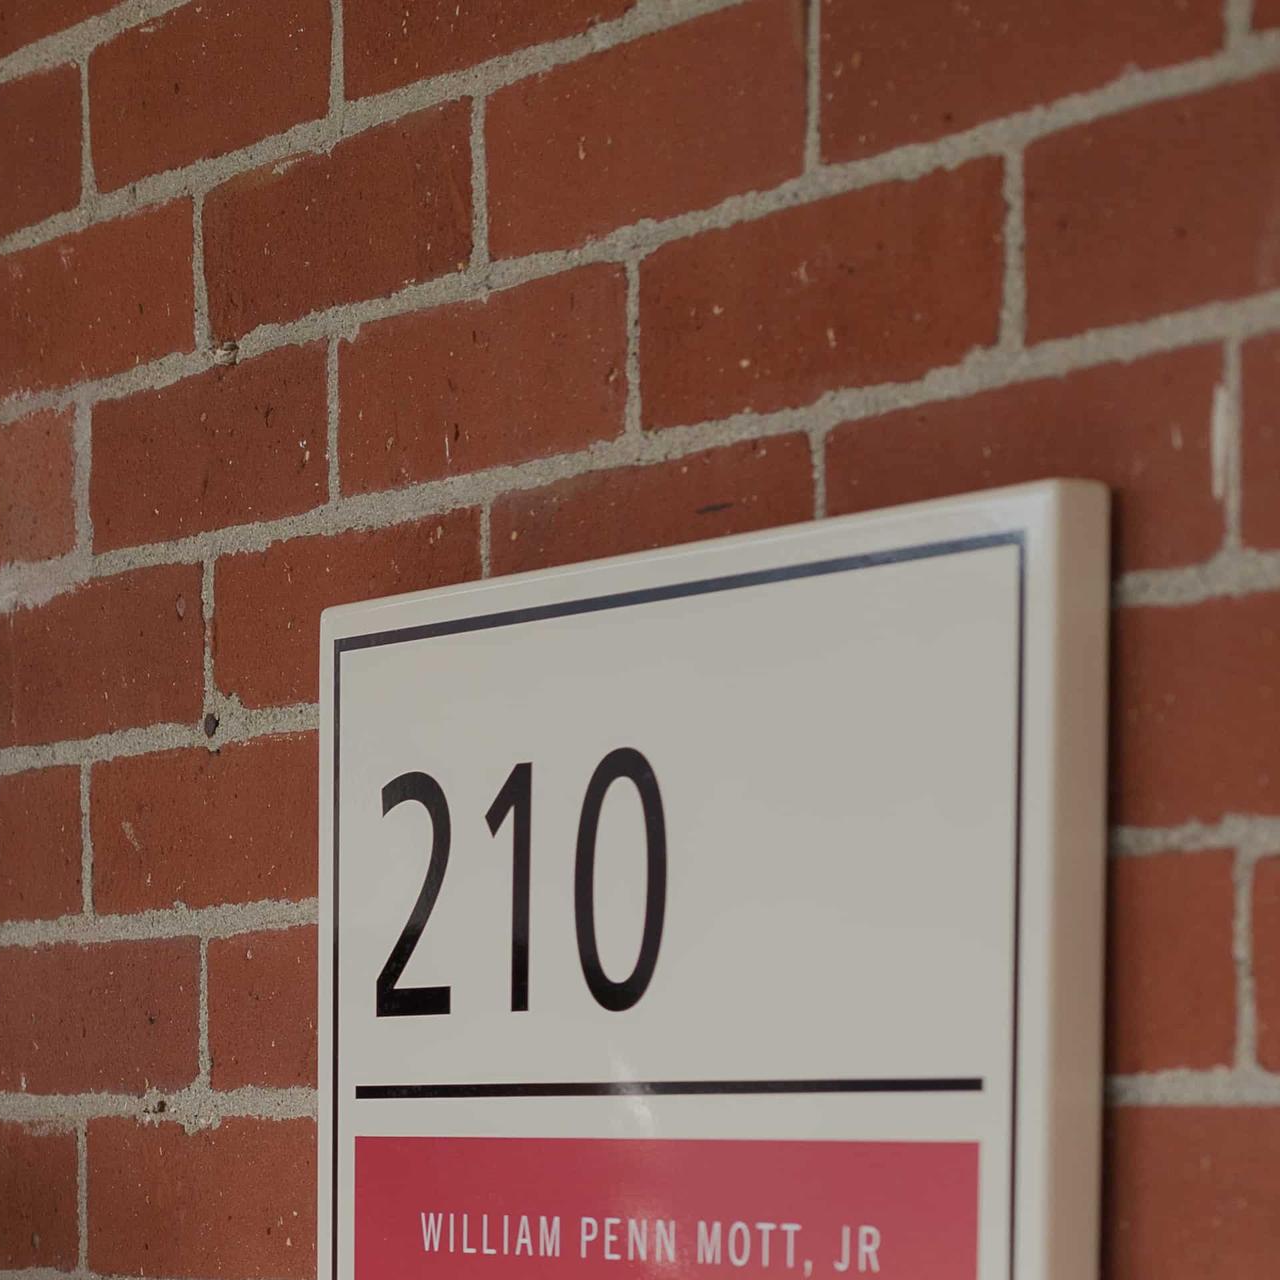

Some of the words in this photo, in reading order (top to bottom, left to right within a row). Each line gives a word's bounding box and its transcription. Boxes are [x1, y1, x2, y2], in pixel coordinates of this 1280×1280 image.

[376, 747, 668, 1017] 210
[420, 1212, 562, 1259] WILLIAM
[581, 1217, 677, 1263] PENN
[697, 1221, 813, 1276] MOTT,
[834, 1226, 882, 1272] JR
